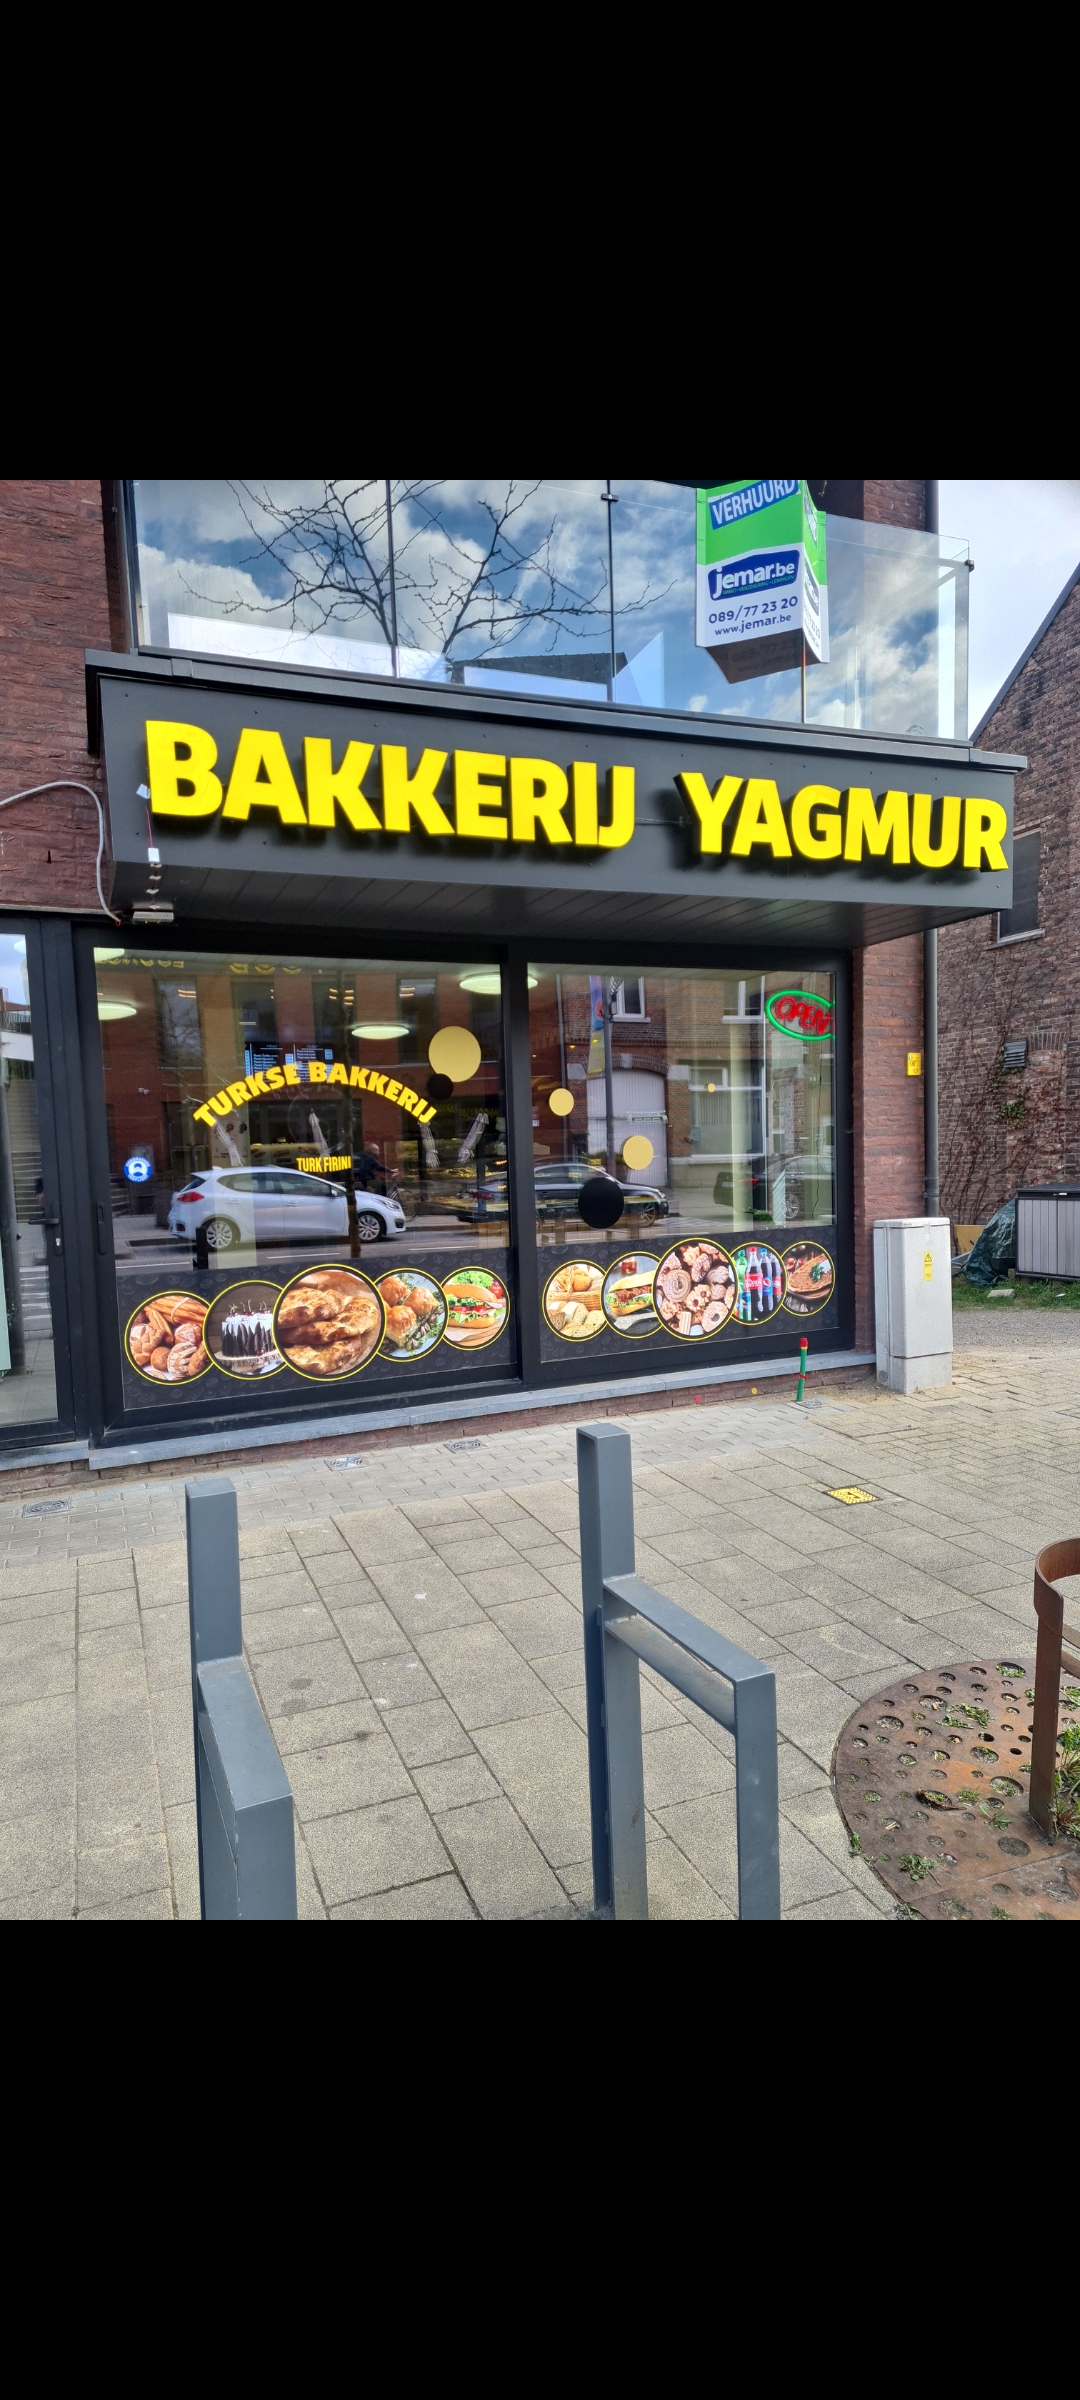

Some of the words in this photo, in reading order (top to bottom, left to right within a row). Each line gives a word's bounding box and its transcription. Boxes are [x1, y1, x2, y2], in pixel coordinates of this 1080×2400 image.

[712, 480, 796, 525] VERHUURD
[712, 562, 796, 600] jemar.be
[708, 604, 759, 624] 089/77
[761, 600, 777, 614] 23
[780, 595, 799, 610] 20
[714, 614, 792, 636] www.jemar.be
[145, 720, 636, 848] BAKKERIJ
[676, 771, 1009, 872] YAGMUR
[775, 995, 832, 1035] OPEN
[192, 1063, 301, 1128] TURKSE
[308, 1061, 437, 1125] BAKKERIJ
[296, 1156, 323, 1173] TURK
[323, 1155, 352, 1173] FIRINI
